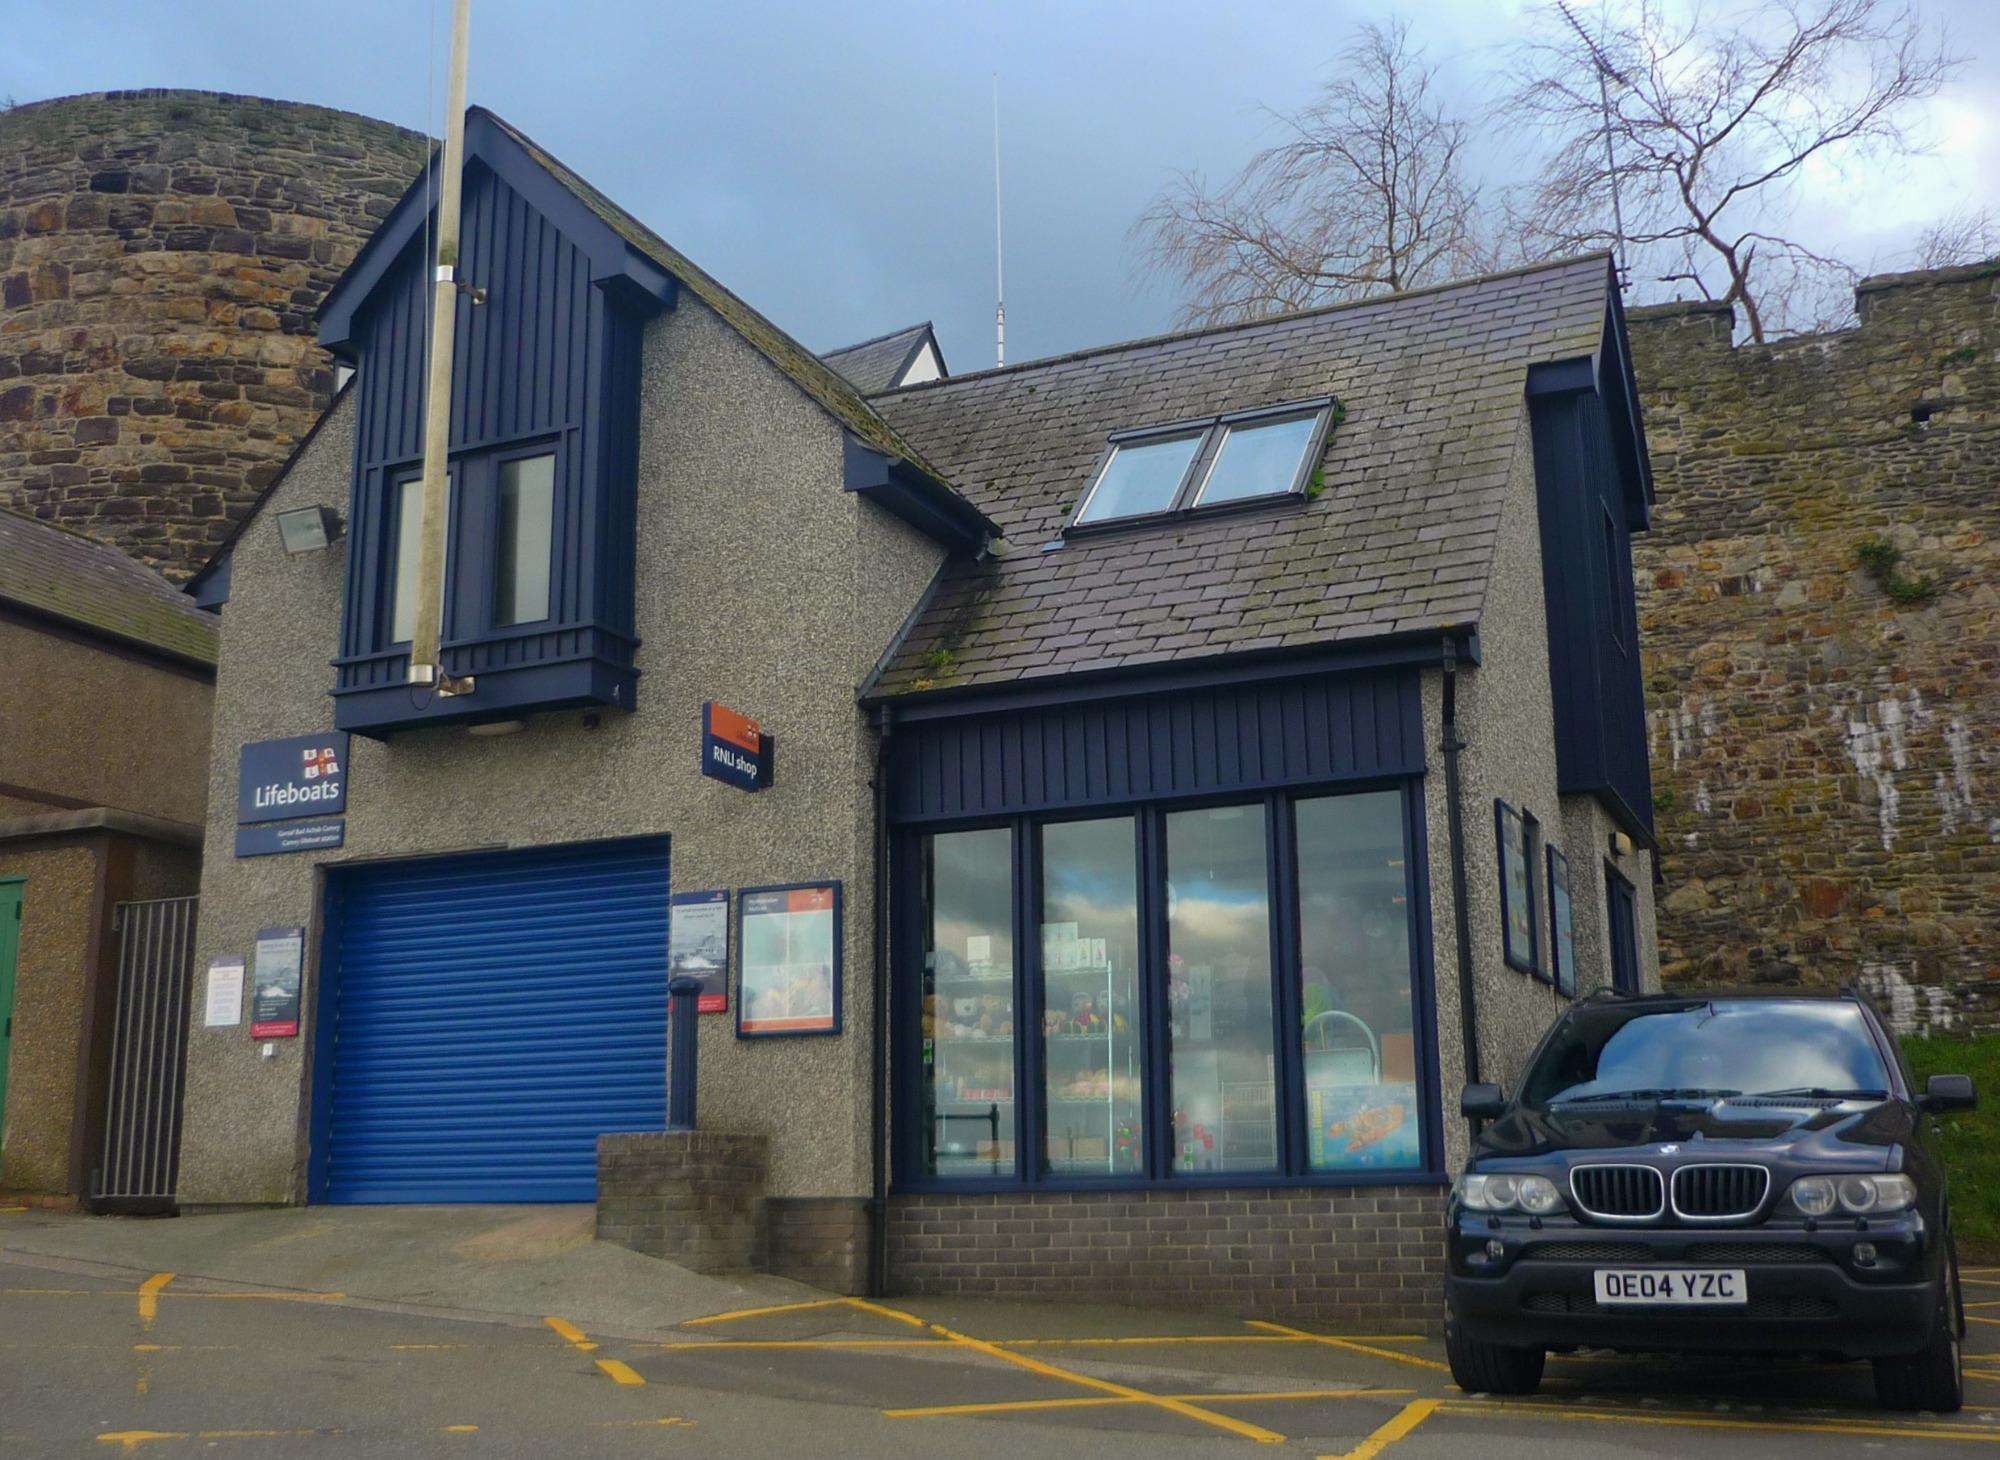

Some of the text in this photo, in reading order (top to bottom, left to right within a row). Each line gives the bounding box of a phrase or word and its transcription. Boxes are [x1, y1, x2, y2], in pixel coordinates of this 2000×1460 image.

[713, 745, 758, 779] RNLI shop
[256, 780, 340, 808] Lifeboats
[1681, 1273, 1734, 1298] YZC
